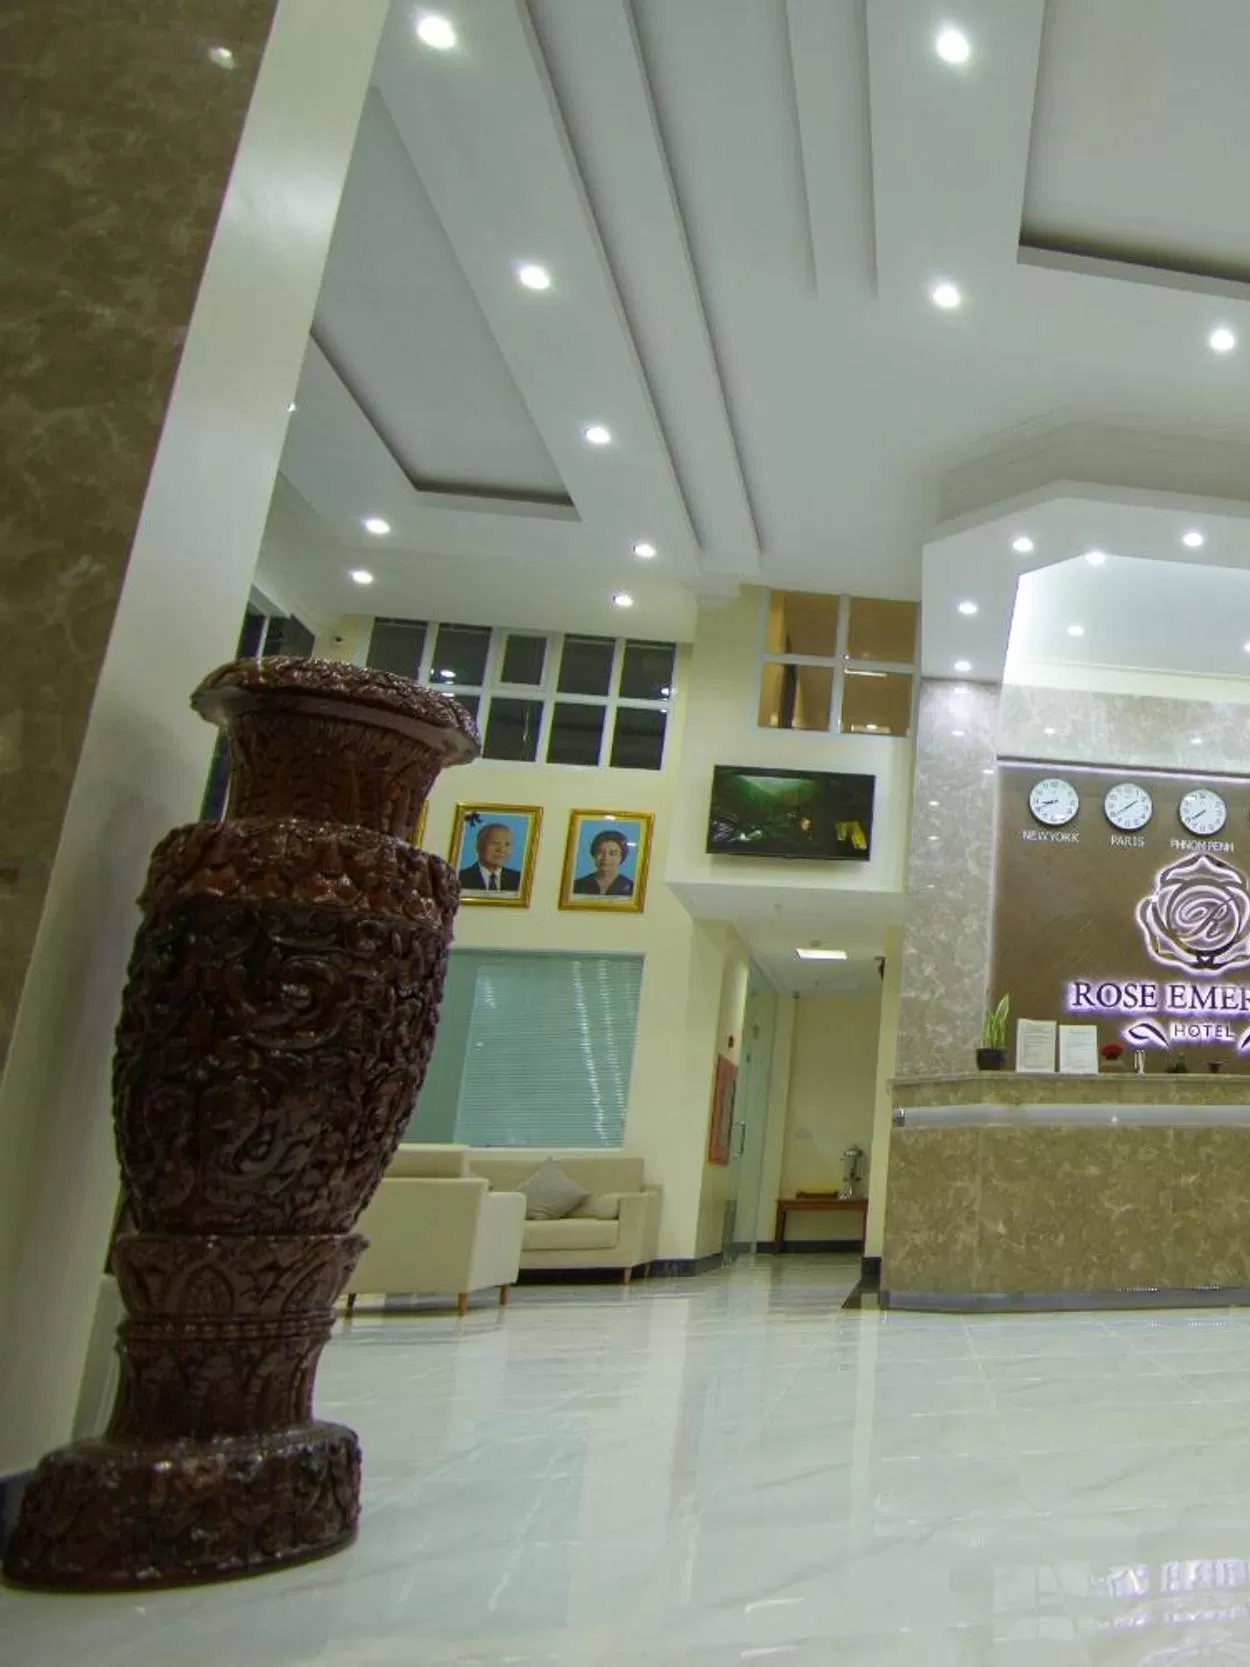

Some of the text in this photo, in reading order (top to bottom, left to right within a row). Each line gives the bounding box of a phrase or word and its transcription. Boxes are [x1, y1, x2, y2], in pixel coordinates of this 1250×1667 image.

[1021, 830, 1080, 844] NEW YORK
[1110, 834, 1145, 848] PARIS
[1169, 839, 1235, 853] PHNOM PENH
[1071, 981, 1158, 1009] ROSE
[1174, 1024, 1235, 1038] HOTEL
